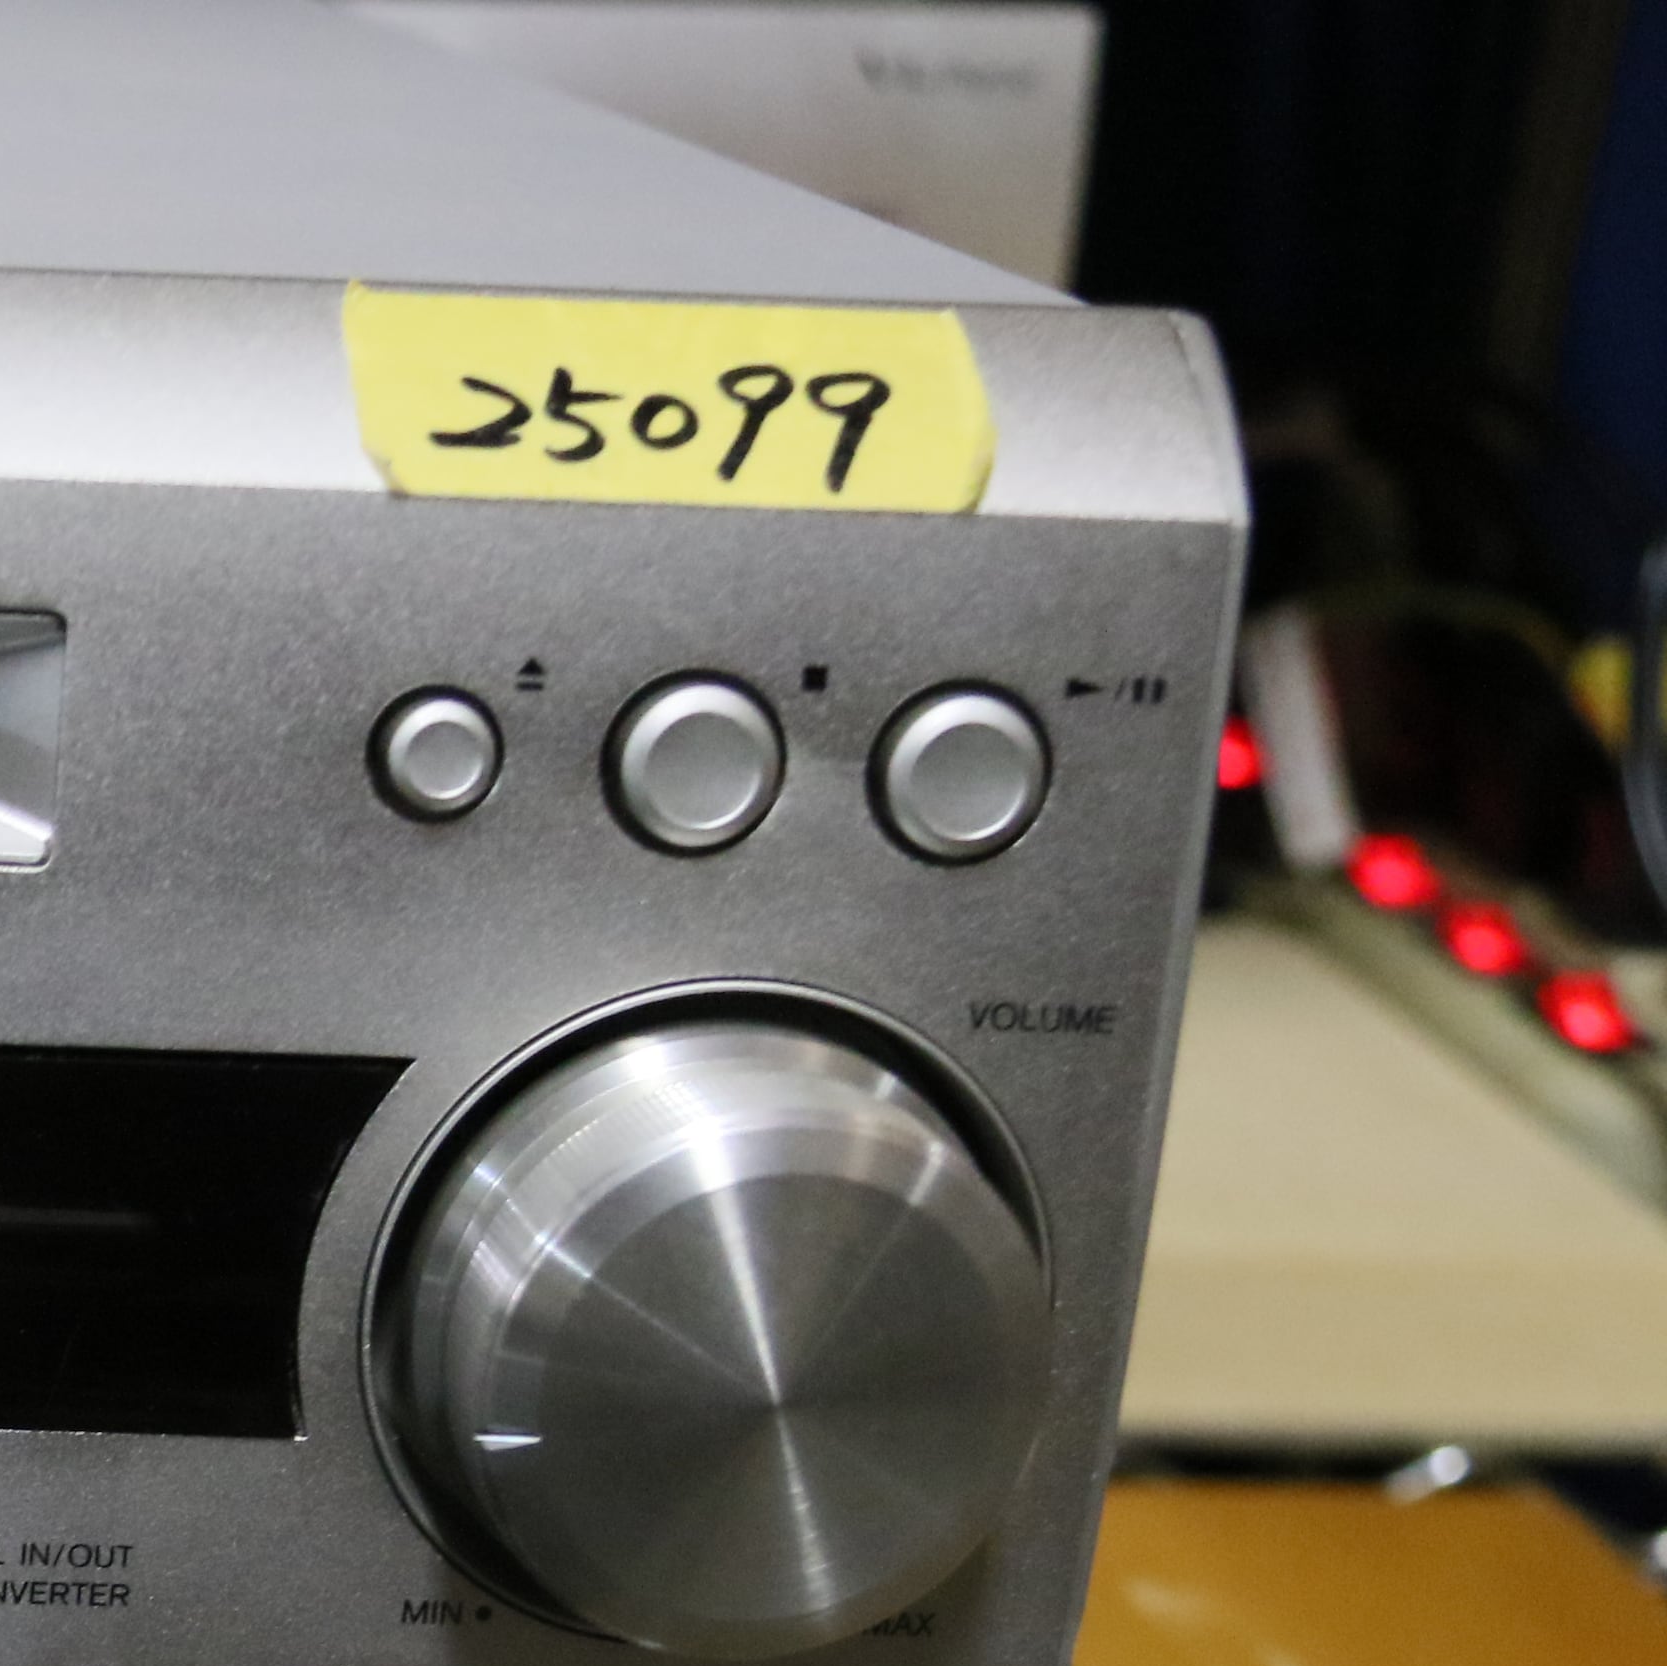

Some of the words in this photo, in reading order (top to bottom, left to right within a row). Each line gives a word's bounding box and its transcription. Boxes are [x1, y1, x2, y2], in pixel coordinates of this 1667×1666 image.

[430, 365, 891, 493] 25099
[970, 1002, 1114, 1034] VOLUME
[20, 1543, 133, 1569] IN/OUT
[400, 1600, 462, 1627] MIN
